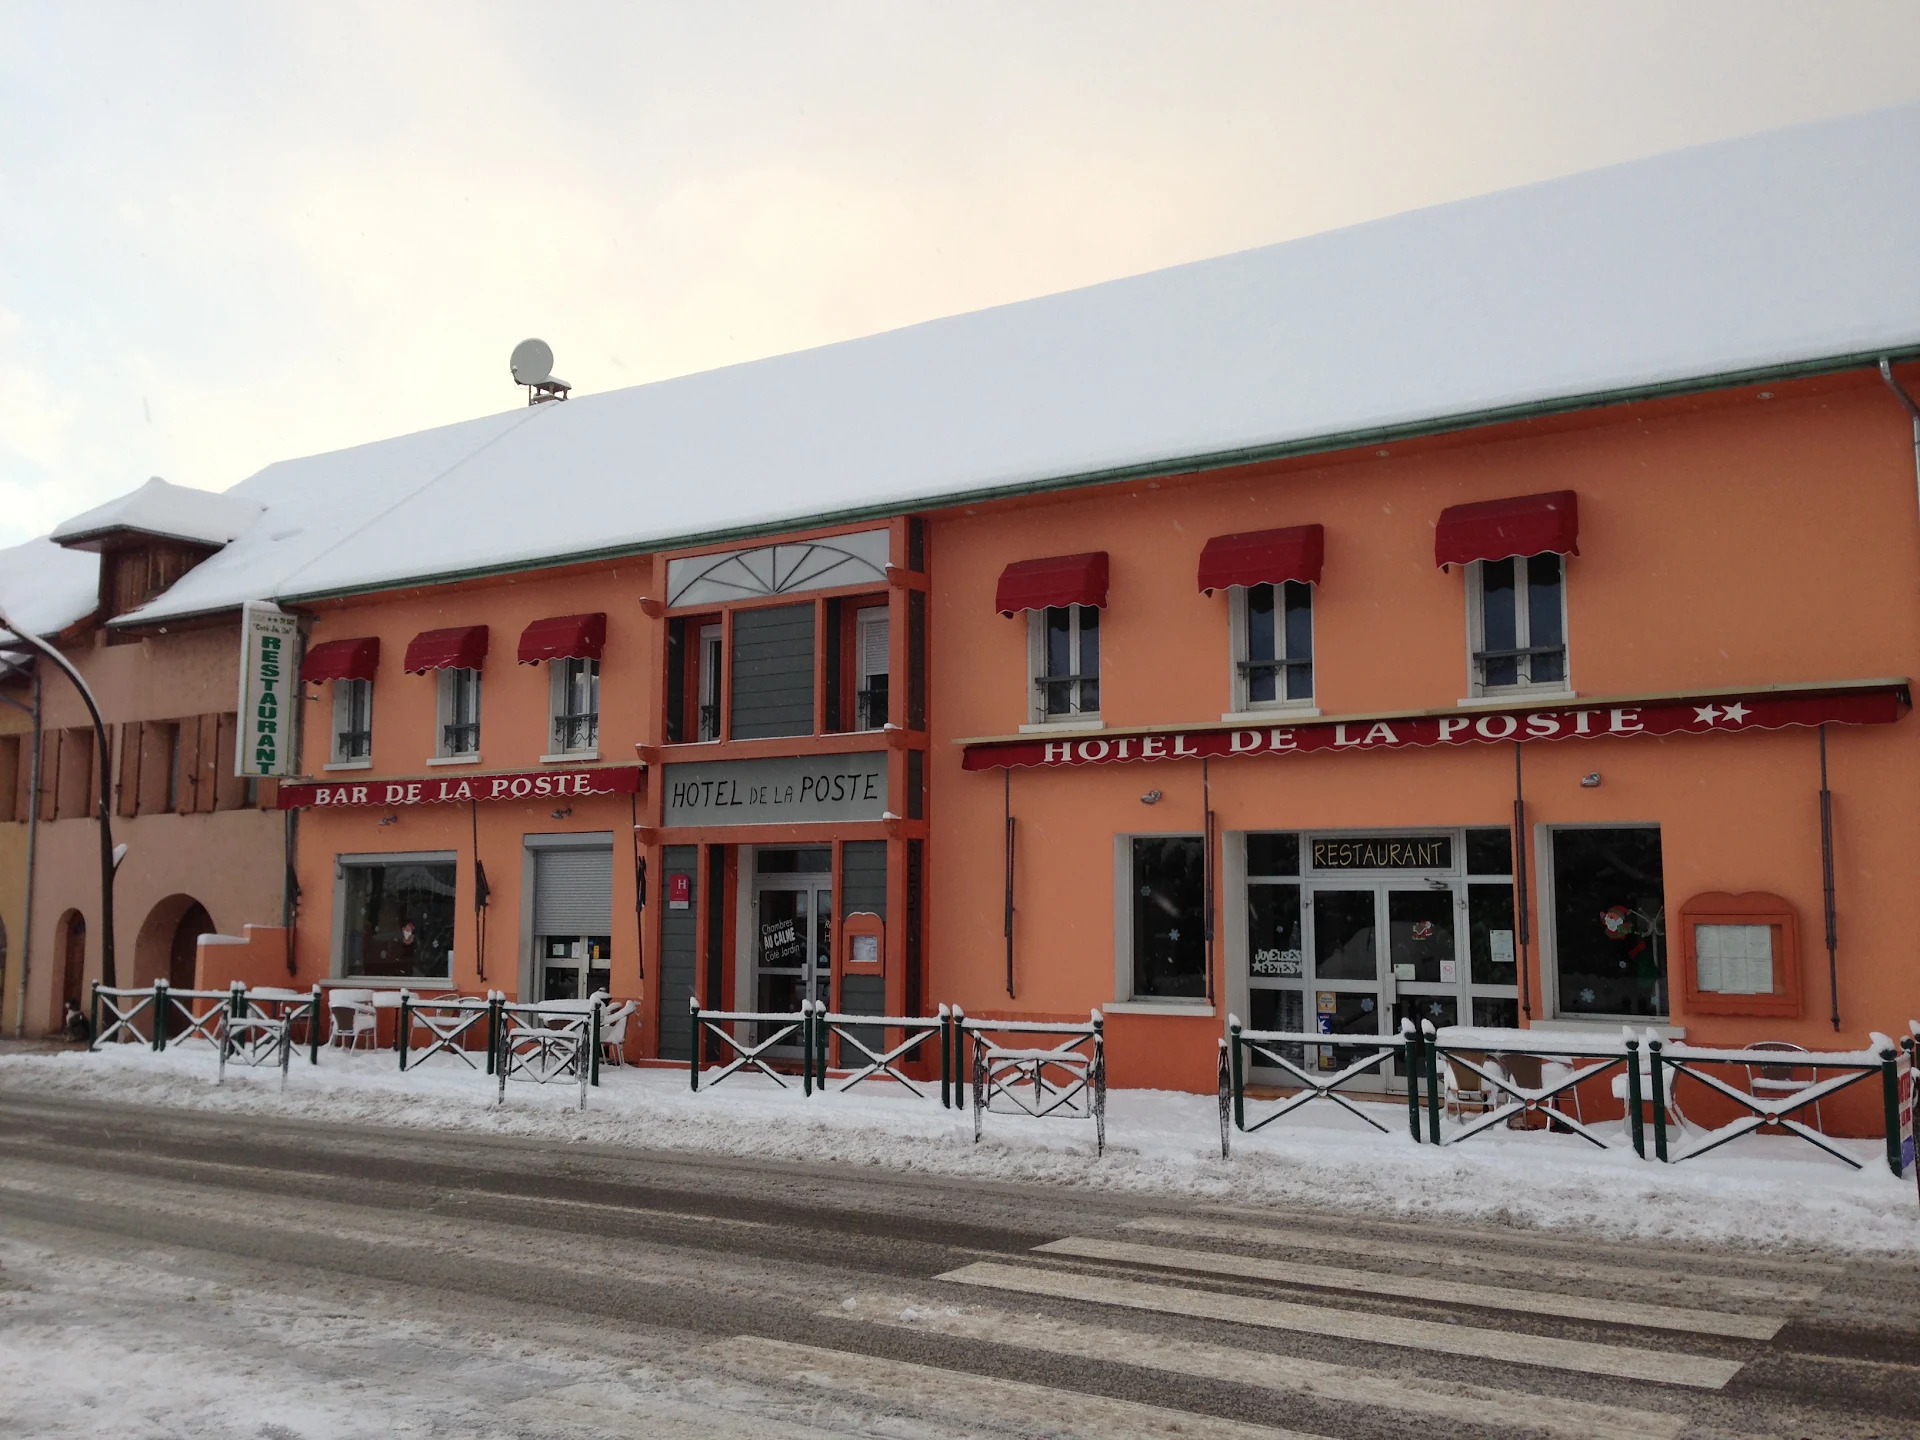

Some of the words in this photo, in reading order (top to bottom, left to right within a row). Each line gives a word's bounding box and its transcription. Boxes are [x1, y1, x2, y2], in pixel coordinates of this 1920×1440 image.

[256, 636, 281, 775] RESTAURANT
[1043, 735, 1198, 762] HOTEL
[1229, 728, 1298, 753] DE
[1333, 721, 1399, 746] LA
[1437, 707, 1645, 741] POSTE
[314, 786, 368, 805] BAR
[385, 783, 422, 804] DE
[438, 780, 472, 800] LA
[491, 774, 592, 798] POSTE
[672, 779, 743, 808] HOTEL
[749, 786, 768, 804] DE
[774, 785, 793, 804] LA
[800, 773, 879, 803] POSTE
[1314, 842, 1443, 866] RESTAURANT
[678, 879, 687, 890] H
[762, 918, 793, 935] Chambres
[764, 935, 773, 950] AU
[774, 927, 796, 947] CALME
[781, 943, 800, 957] Jardin
